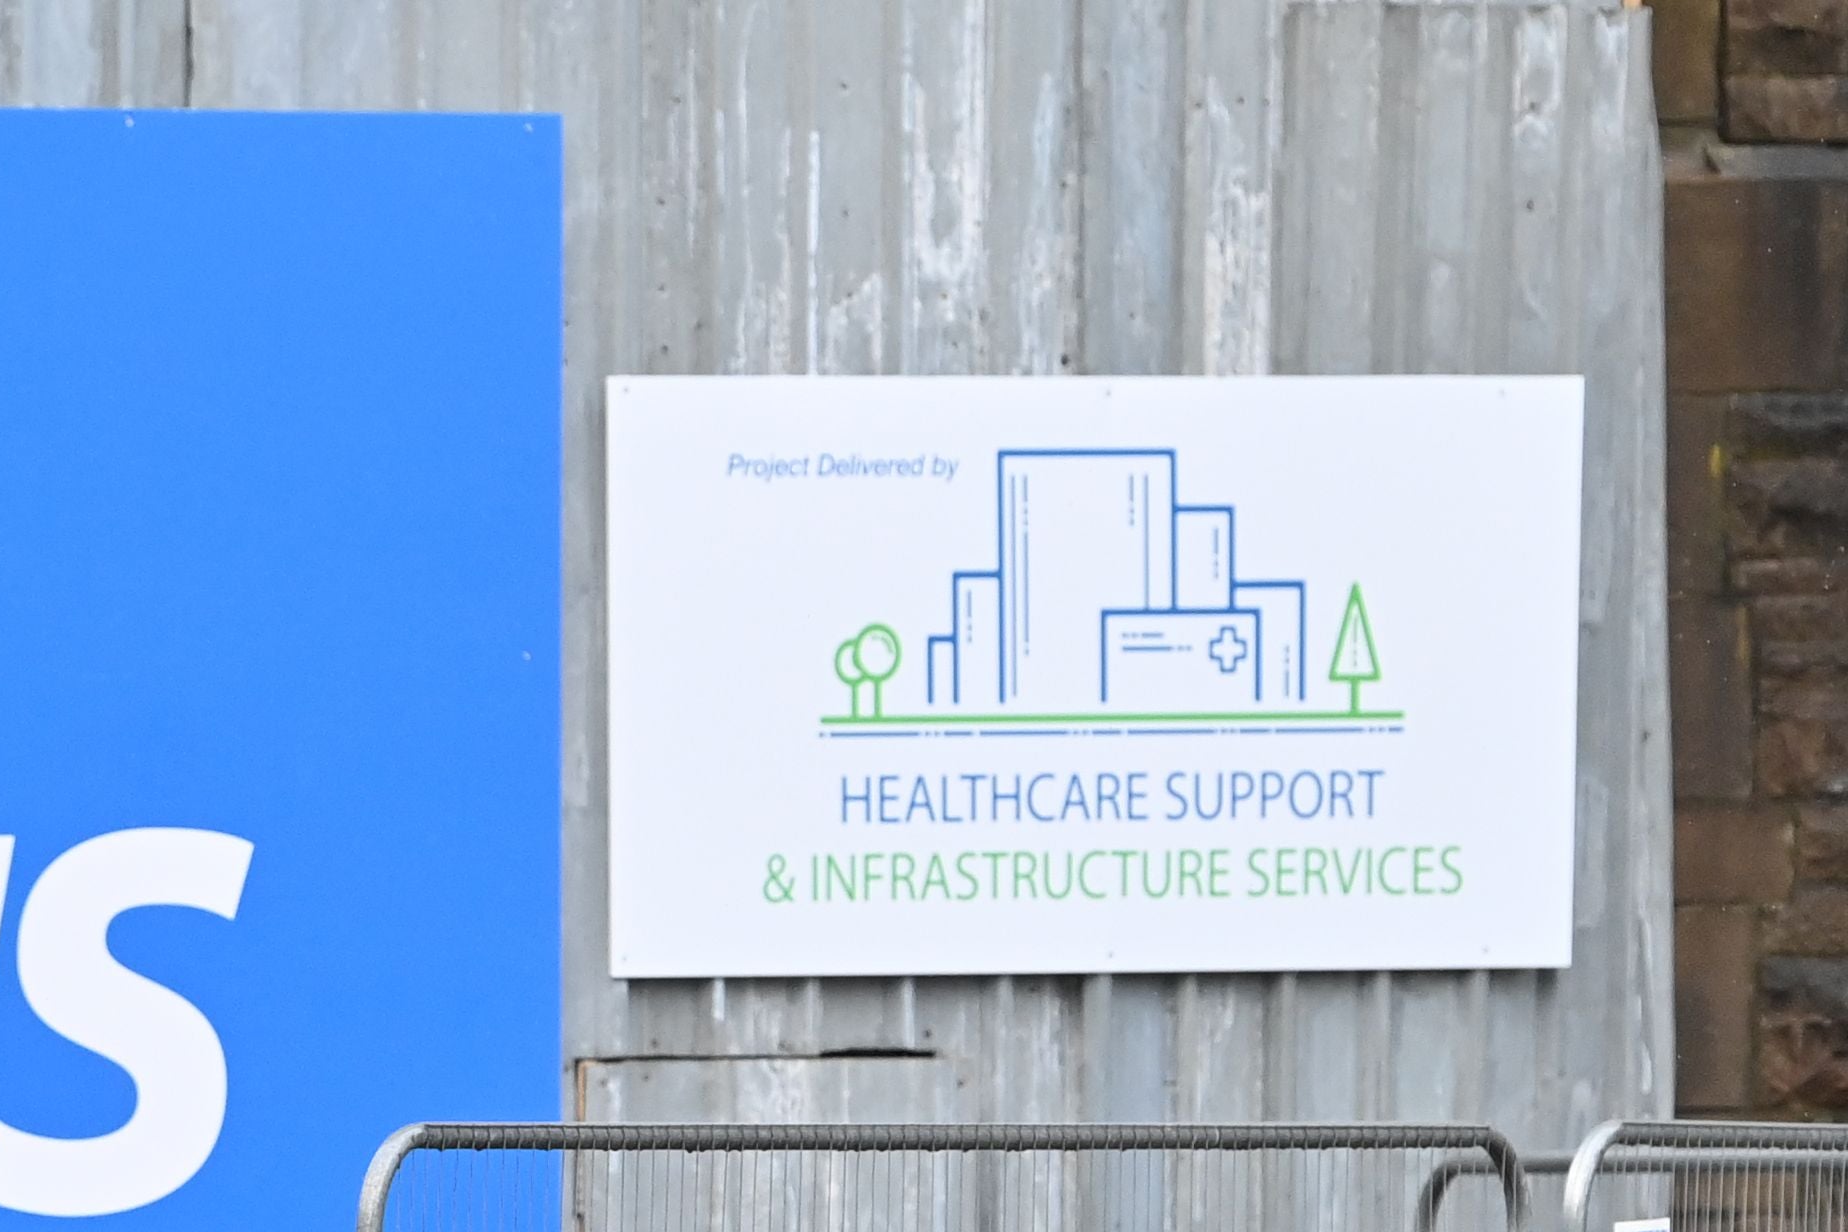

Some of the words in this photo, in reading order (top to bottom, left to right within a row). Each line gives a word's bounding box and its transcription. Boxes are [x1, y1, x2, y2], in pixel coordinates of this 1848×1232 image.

[727, 453, 809, 482] Project
[817, 453, 925, 477] Delivered
[930, 454, 959, 482] by
[839, 772, 1150, 824] HEALTHCARE
[1164, 769, 1386, 821] SUPPORT
[762, 853, 796, 904] &
[810, 849, 1231, 901] INFRASTRUCTURE
[1246, 845, 1464, 897] SERVICES
